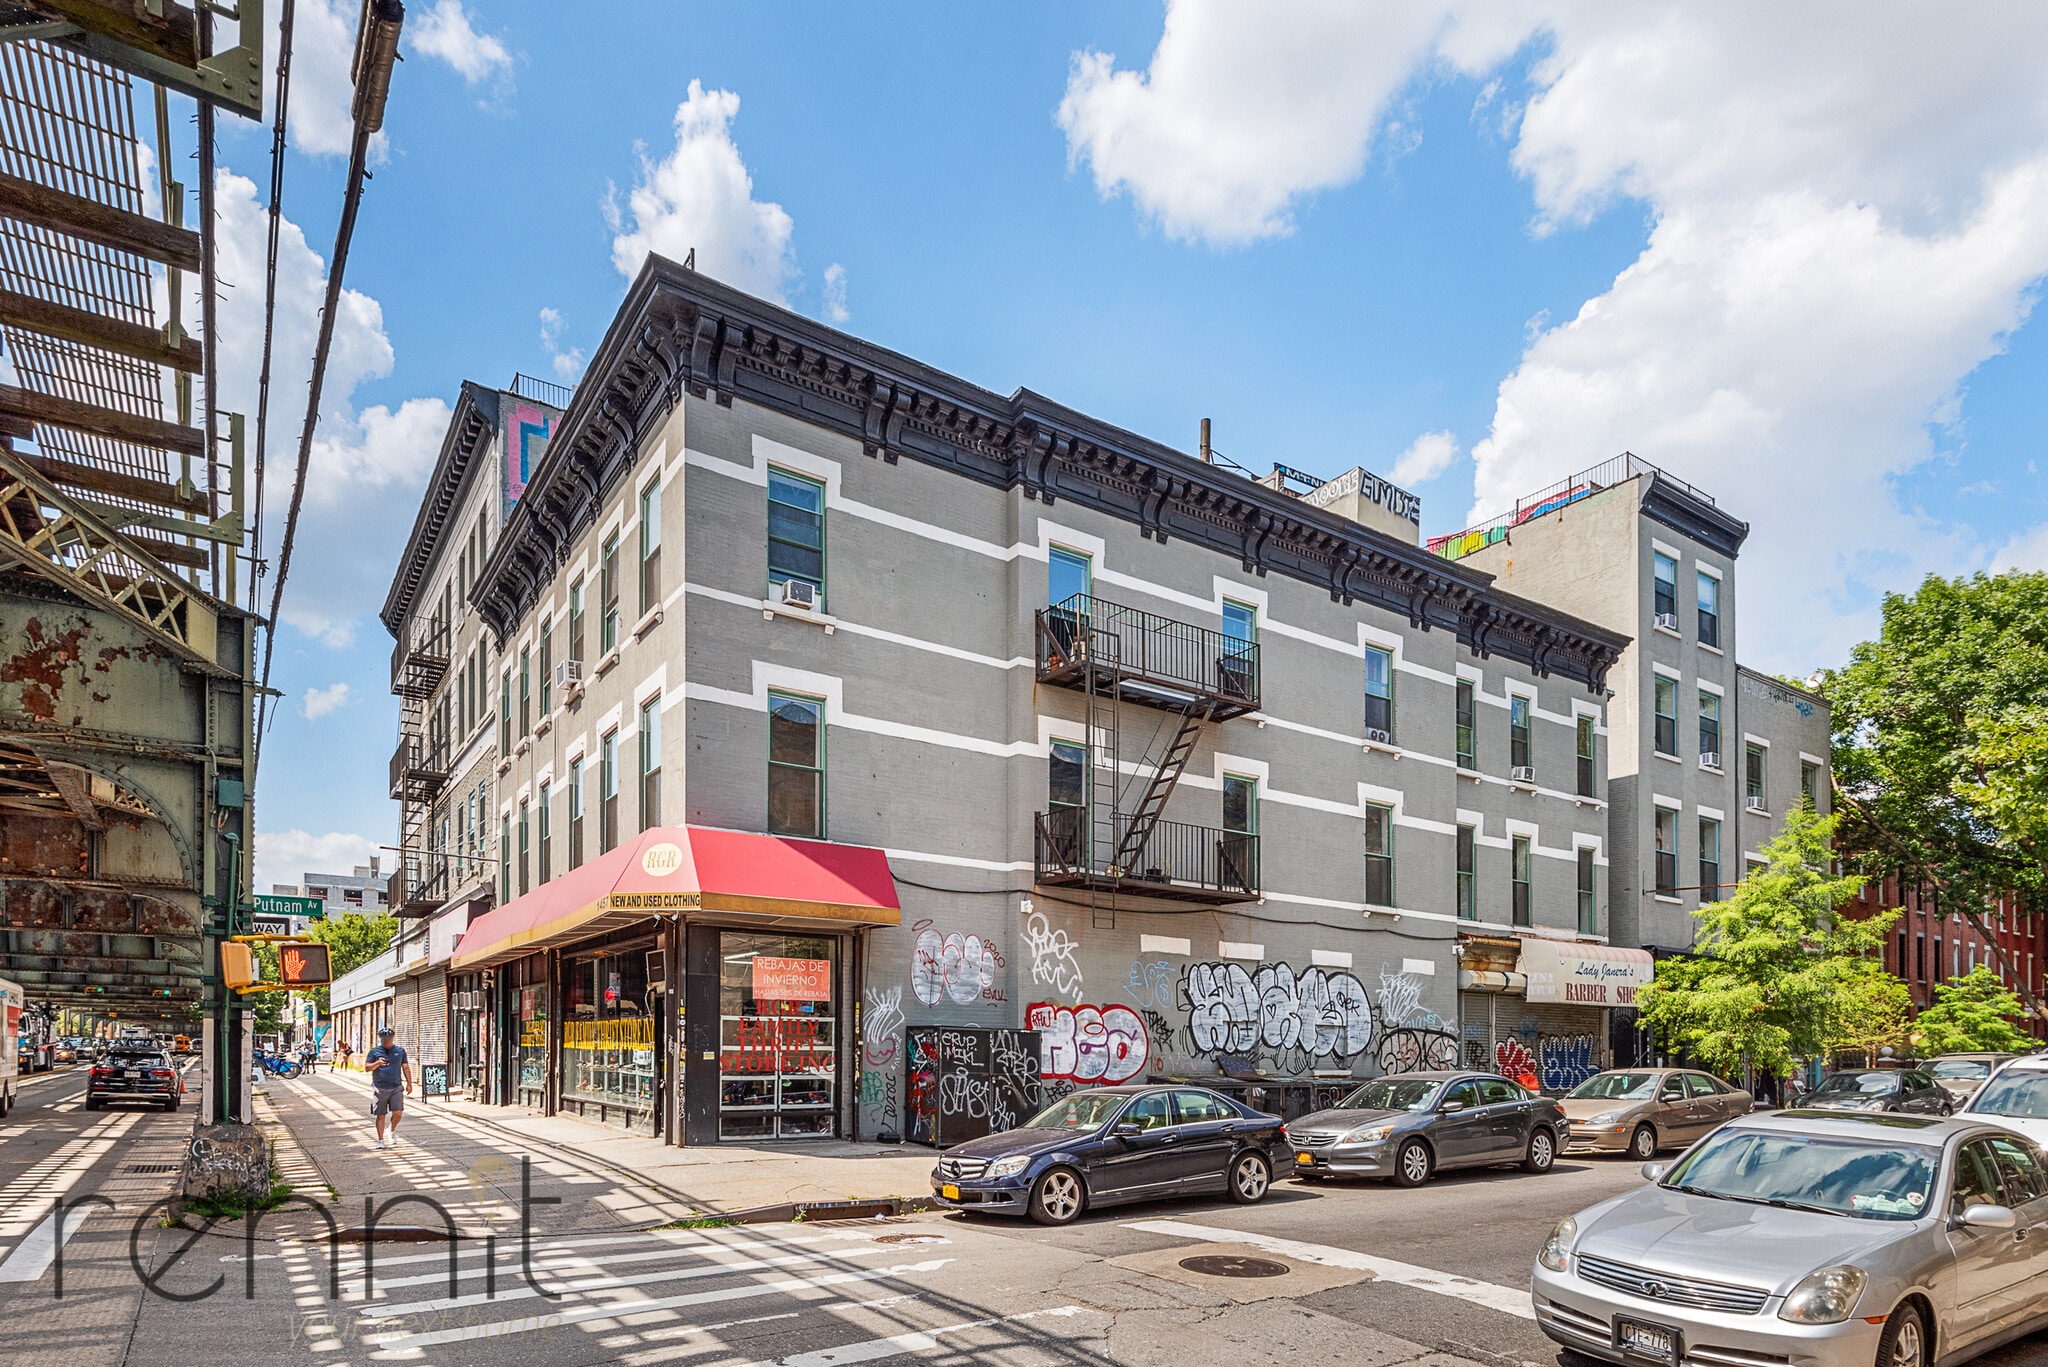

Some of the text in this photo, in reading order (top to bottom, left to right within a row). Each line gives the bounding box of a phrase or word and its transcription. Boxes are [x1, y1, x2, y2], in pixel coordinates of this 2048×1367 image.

[647, 850, 676, 869] RGR
[254, 897, 318, 913] Putnam Av
[611, 894, 700, 908] NEW AND USED CLOTHING
[254, 924, 282, 934] WAY
[758, 958, 824, 972] REBAJAS DE
[1575, 961, 1600, 980] Lady
[763, 974, 817, 987] INVIERNO
[780, 989, 793, 997] 50%
[1565, 982, 1607, 1003] BARBER
[1616, 986, 1639, 1004] SHO
[755, 998, 802, 1017] RGR
[738, 1017, 819, 1035] FAMILY
[735, 1035, 820, 1055] THRIFT
